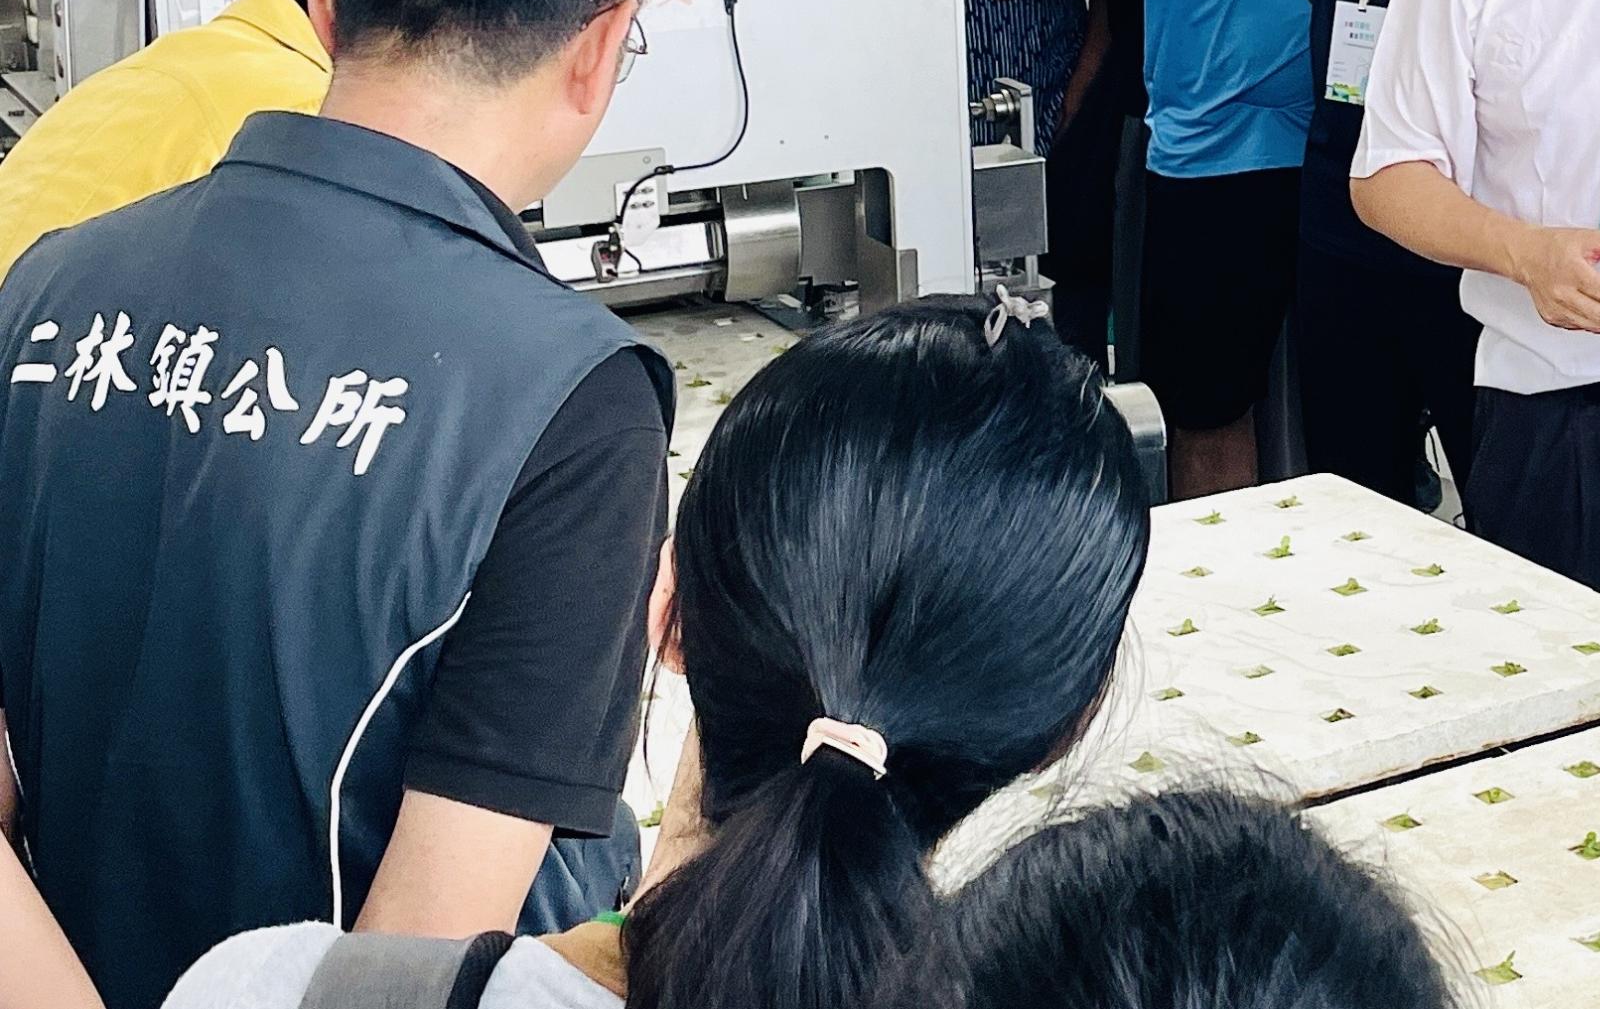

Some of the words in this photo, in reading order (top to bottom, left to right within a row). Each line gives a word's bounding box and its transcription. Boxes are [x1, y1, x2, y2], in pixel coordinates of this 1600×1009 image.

[10, 311, 409, 475] 二林鎮公所
